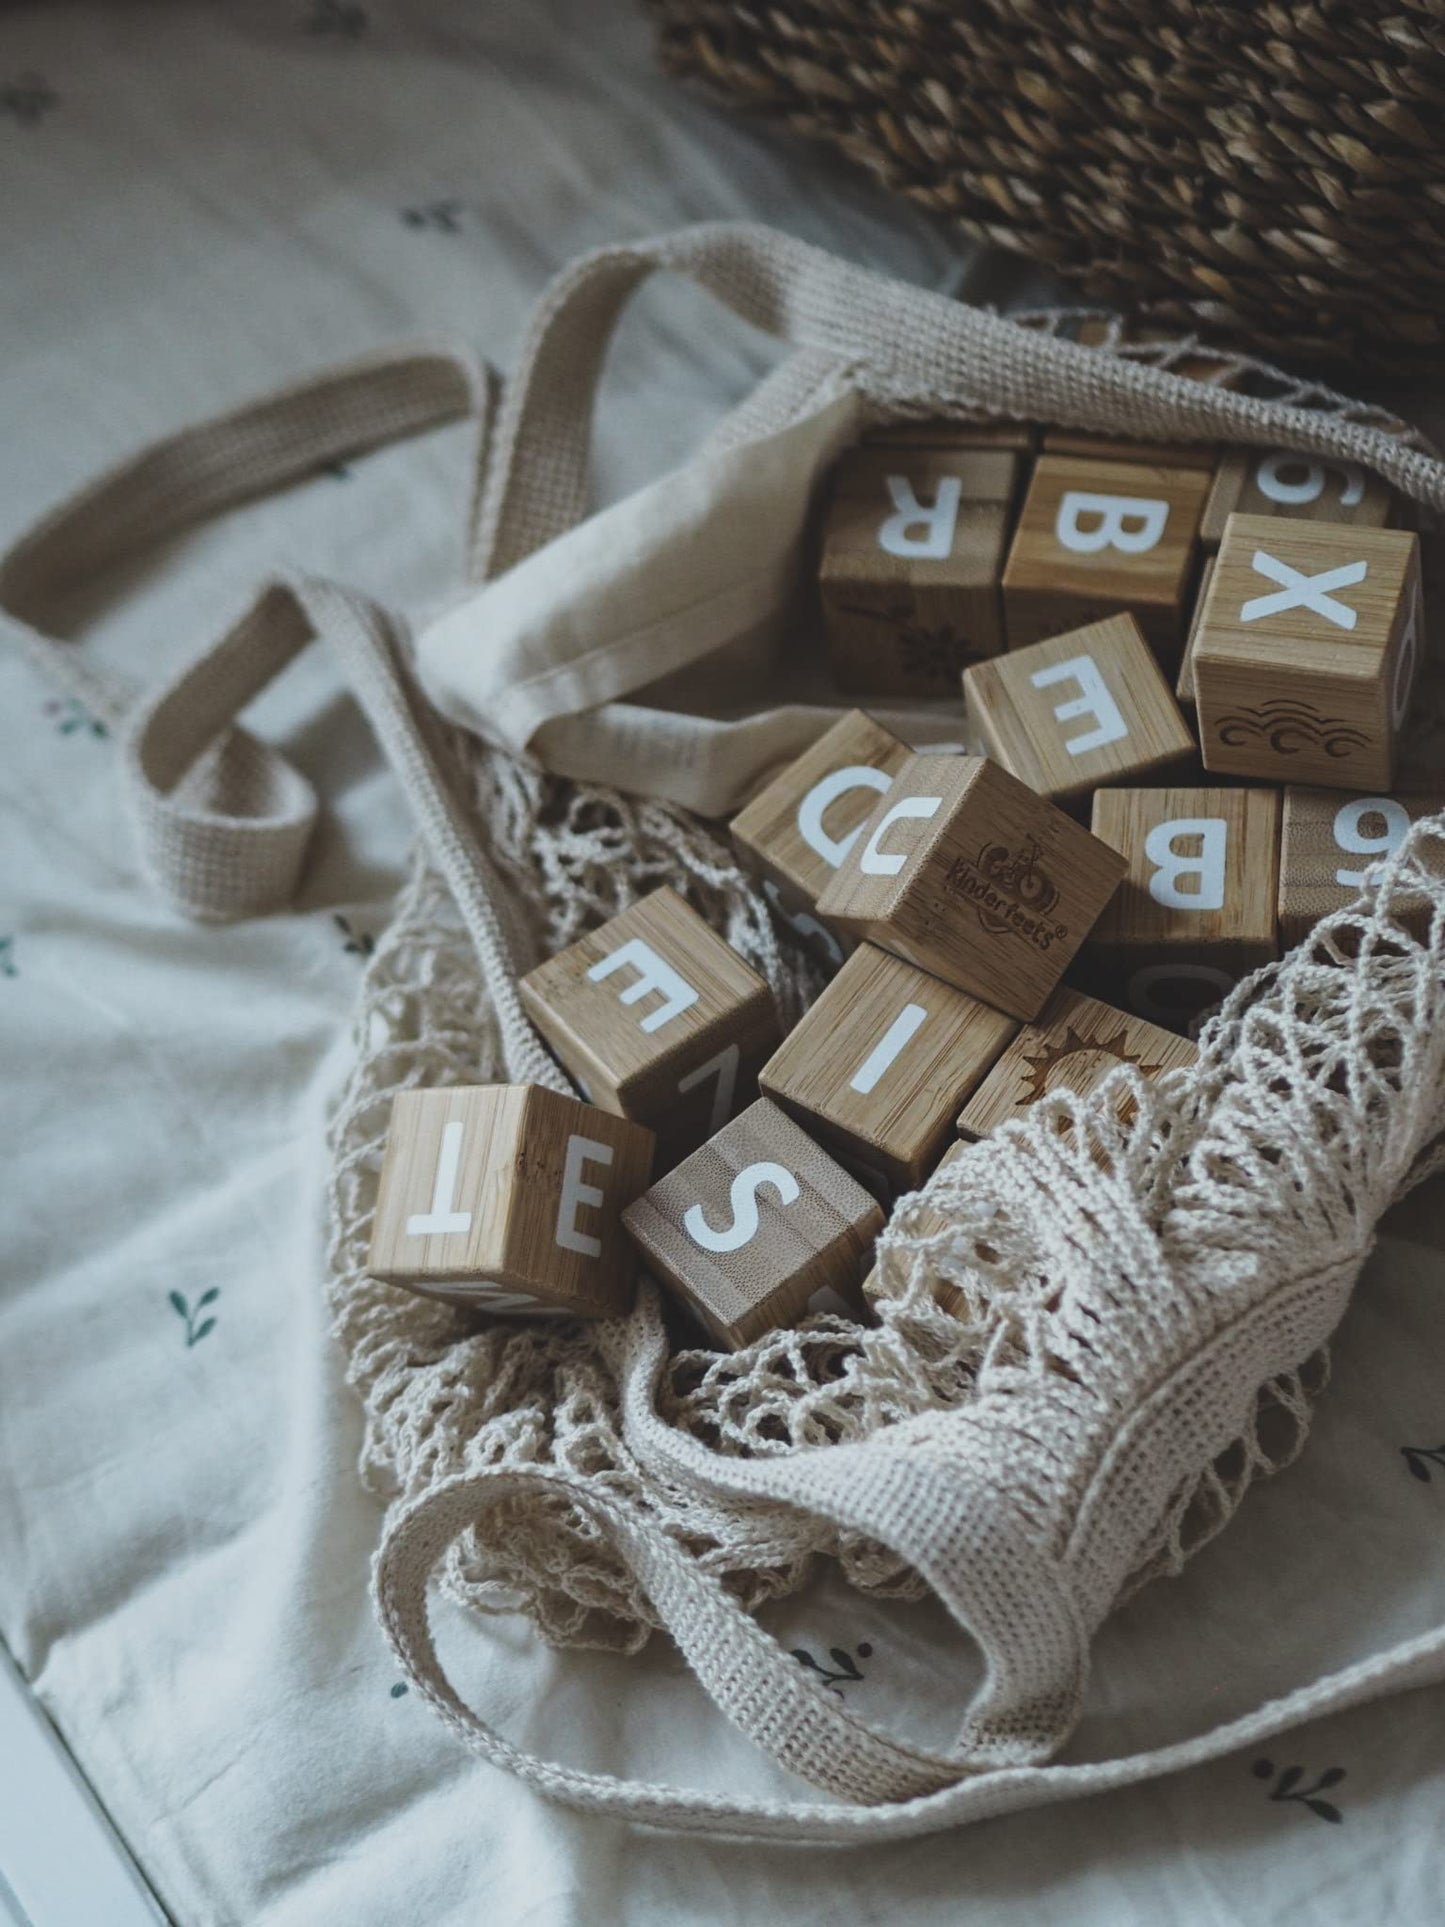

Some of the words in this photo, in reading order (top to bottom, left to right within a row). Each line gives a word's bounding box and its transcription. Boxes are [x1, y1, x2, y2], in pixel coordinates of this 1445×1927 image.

[877, 475, 963, 559] R
[1056, 492, 1169, 554] B
[1240, 550, 1368, 631] X
[1030, 654, 1129, 757] E
[1143, 818, 1228, 910] B
[586, 937, 700, 1034] E
[405, 1120, 472, 1237] T
[554, 1133, 614, 1258] E
[683, 1161, 800, 1253] S
